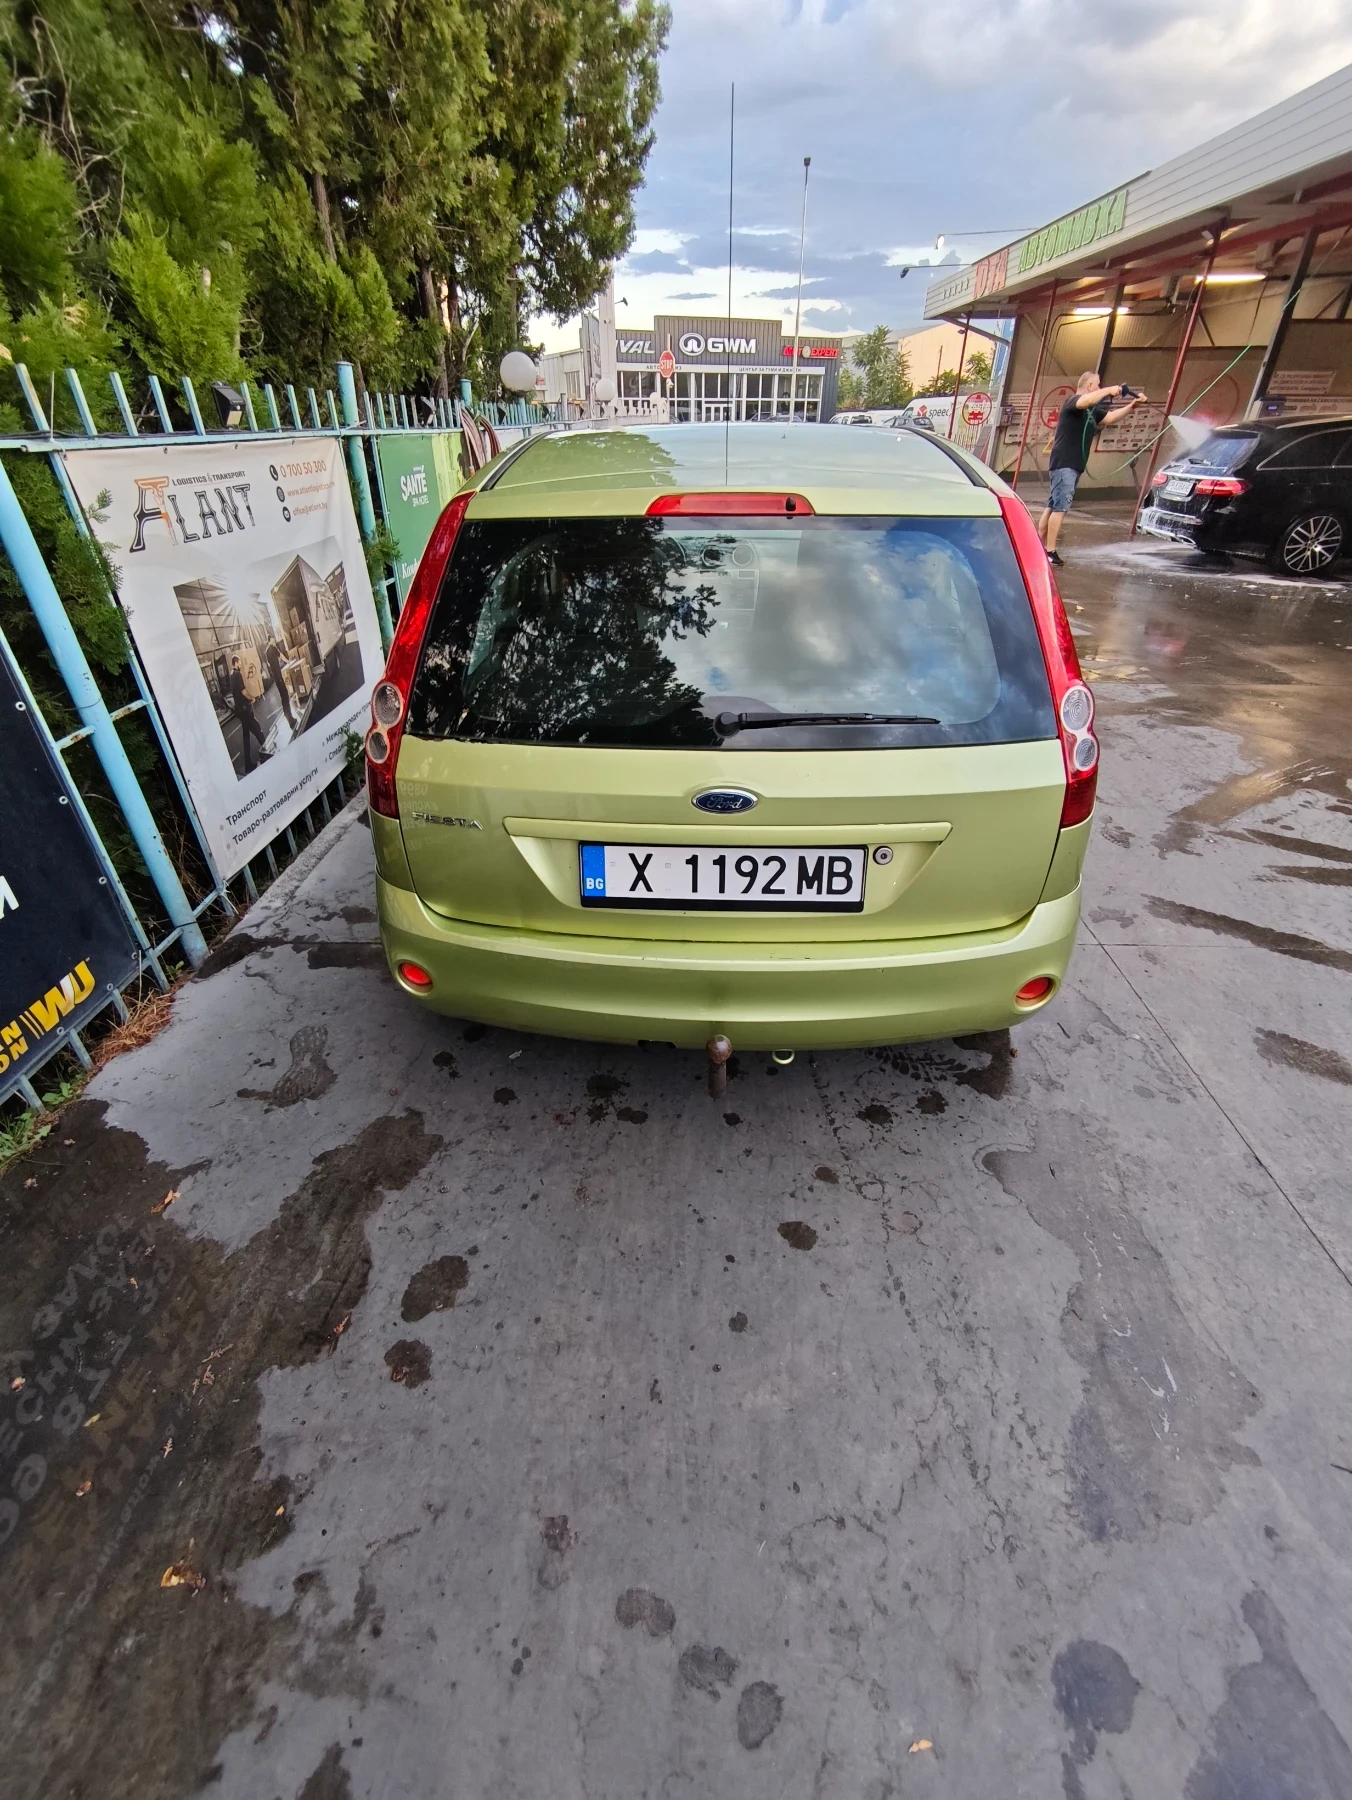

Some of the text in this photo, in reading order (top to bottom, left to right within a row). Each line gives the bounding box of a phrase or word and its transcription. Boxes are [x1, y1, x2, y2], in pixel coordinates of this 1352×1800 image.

[1017, 190, 1127, 273] АВТОМИВКА
[615, 340, 655, 354] VAL
[707, 338, 756, 354] GWM
[661, 360, 673, 370] STOP
[286, 463, 303, 477] 700
[303, 462, 313, 475] 50
[313, 460, 327, 473] 300
[226, 790, 267, 826] Транспорт
[232, 767, 319, 845] Товаро-разтоварни услуги
[706, 794, 743, 809] Ford
[411, 811, 484, 831] FIESTA
[685, 854, 786, 895] 1192
[796, 856, 854, 895] MB
[586, 878, 604, 890] BG
